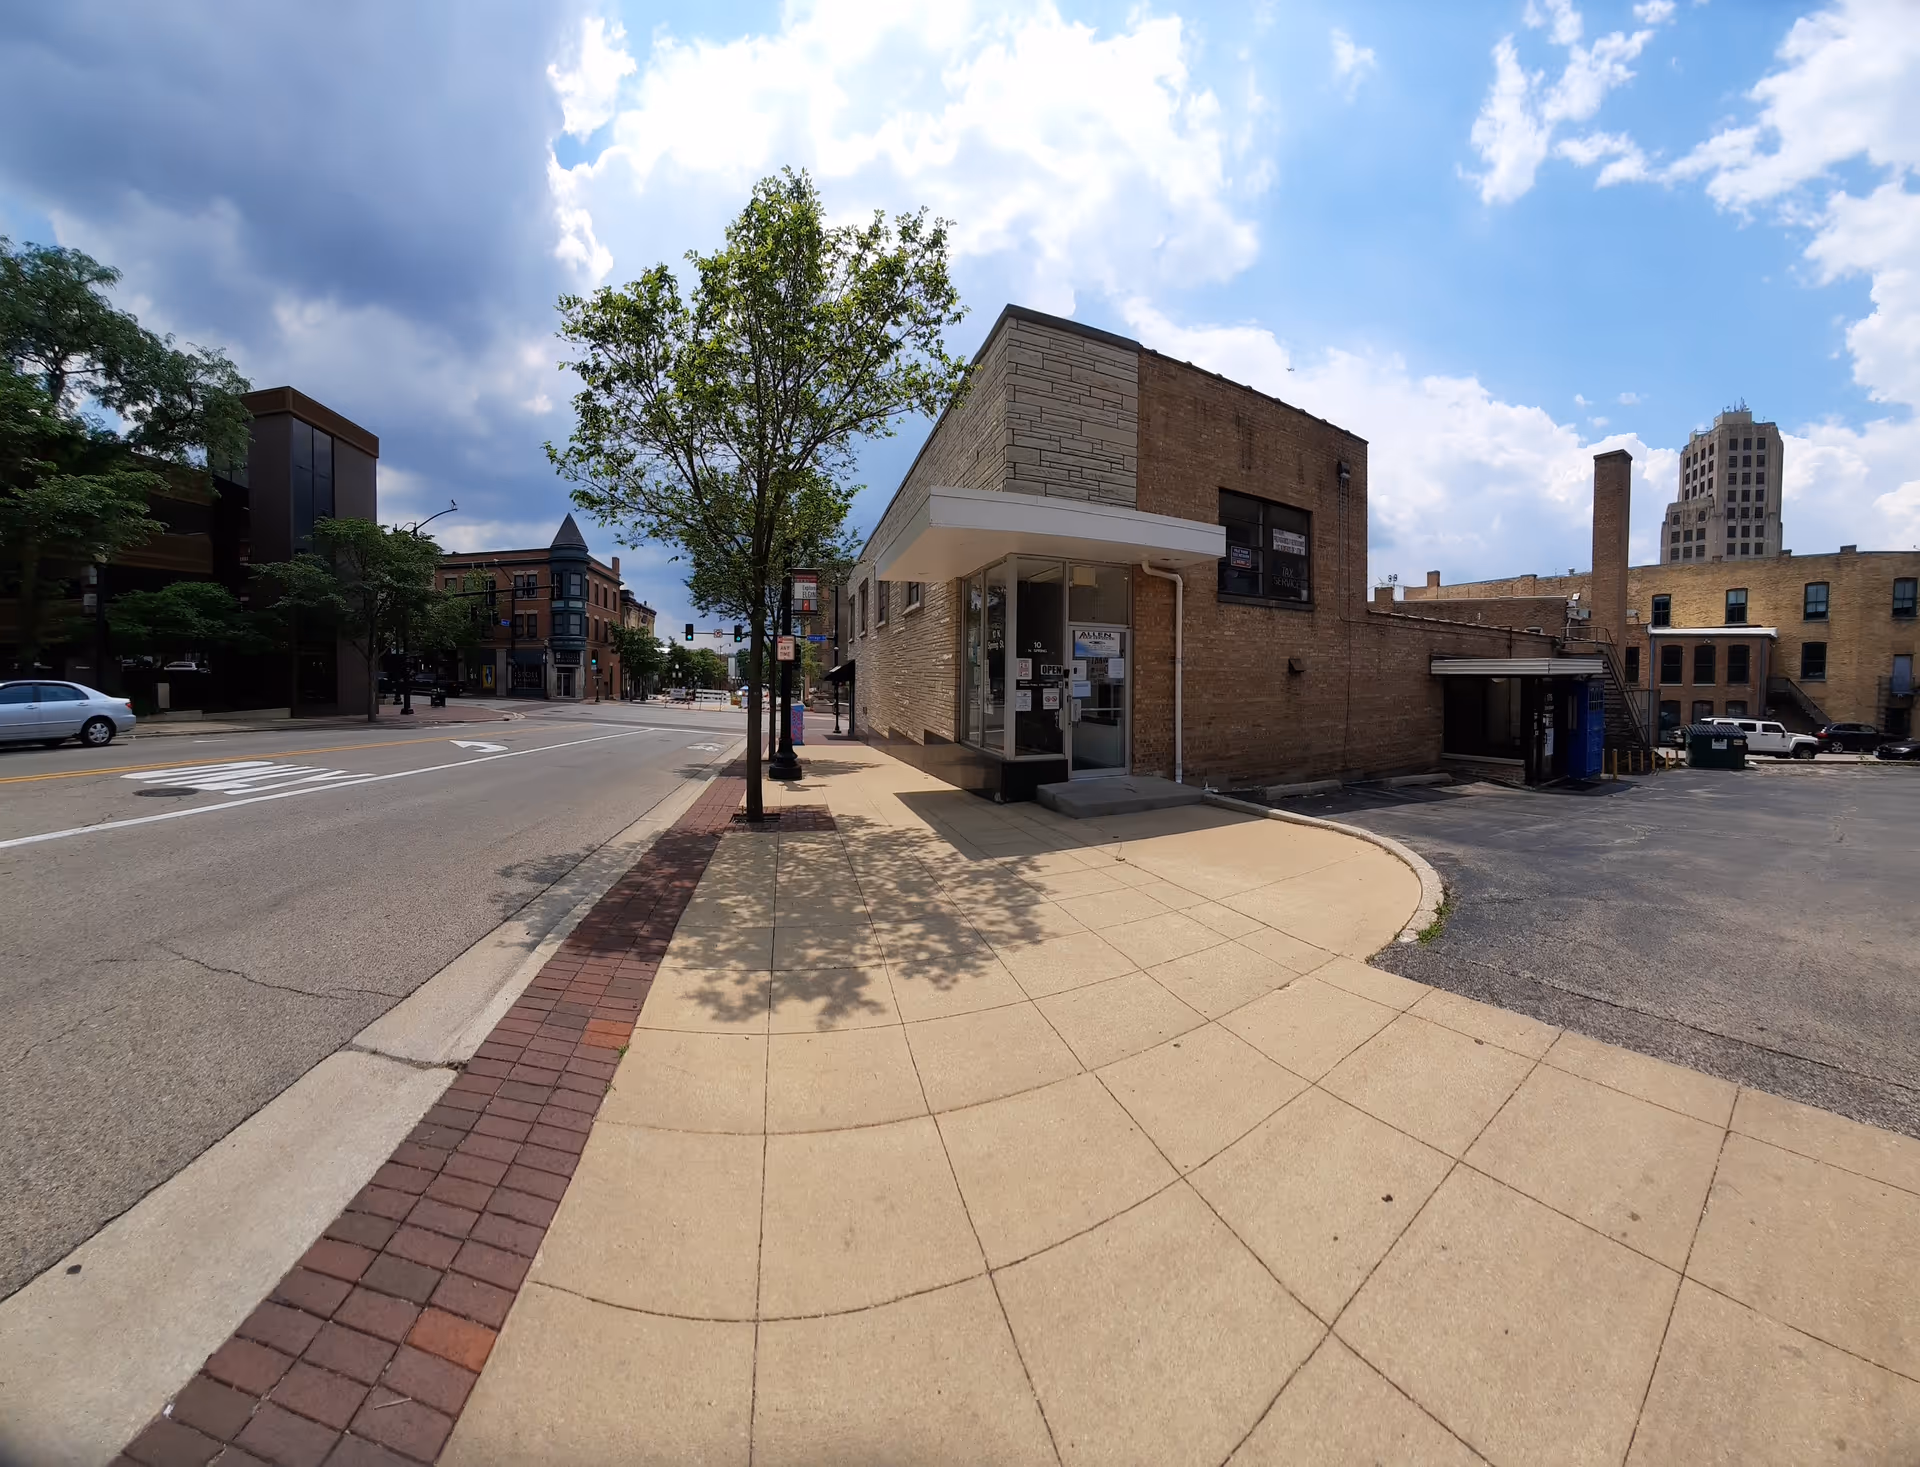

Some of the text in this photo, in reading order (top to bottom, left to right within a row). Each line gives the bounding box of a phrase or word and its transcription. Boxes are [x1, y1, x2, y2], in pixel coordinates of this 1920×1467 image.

[1282, 567, 1294, 577] TAX
[1079, 631, 1112, 639] ALLEN
[1042, 665, 1062, 674] OPEN
[120, 761, 377, 795] ONLY
